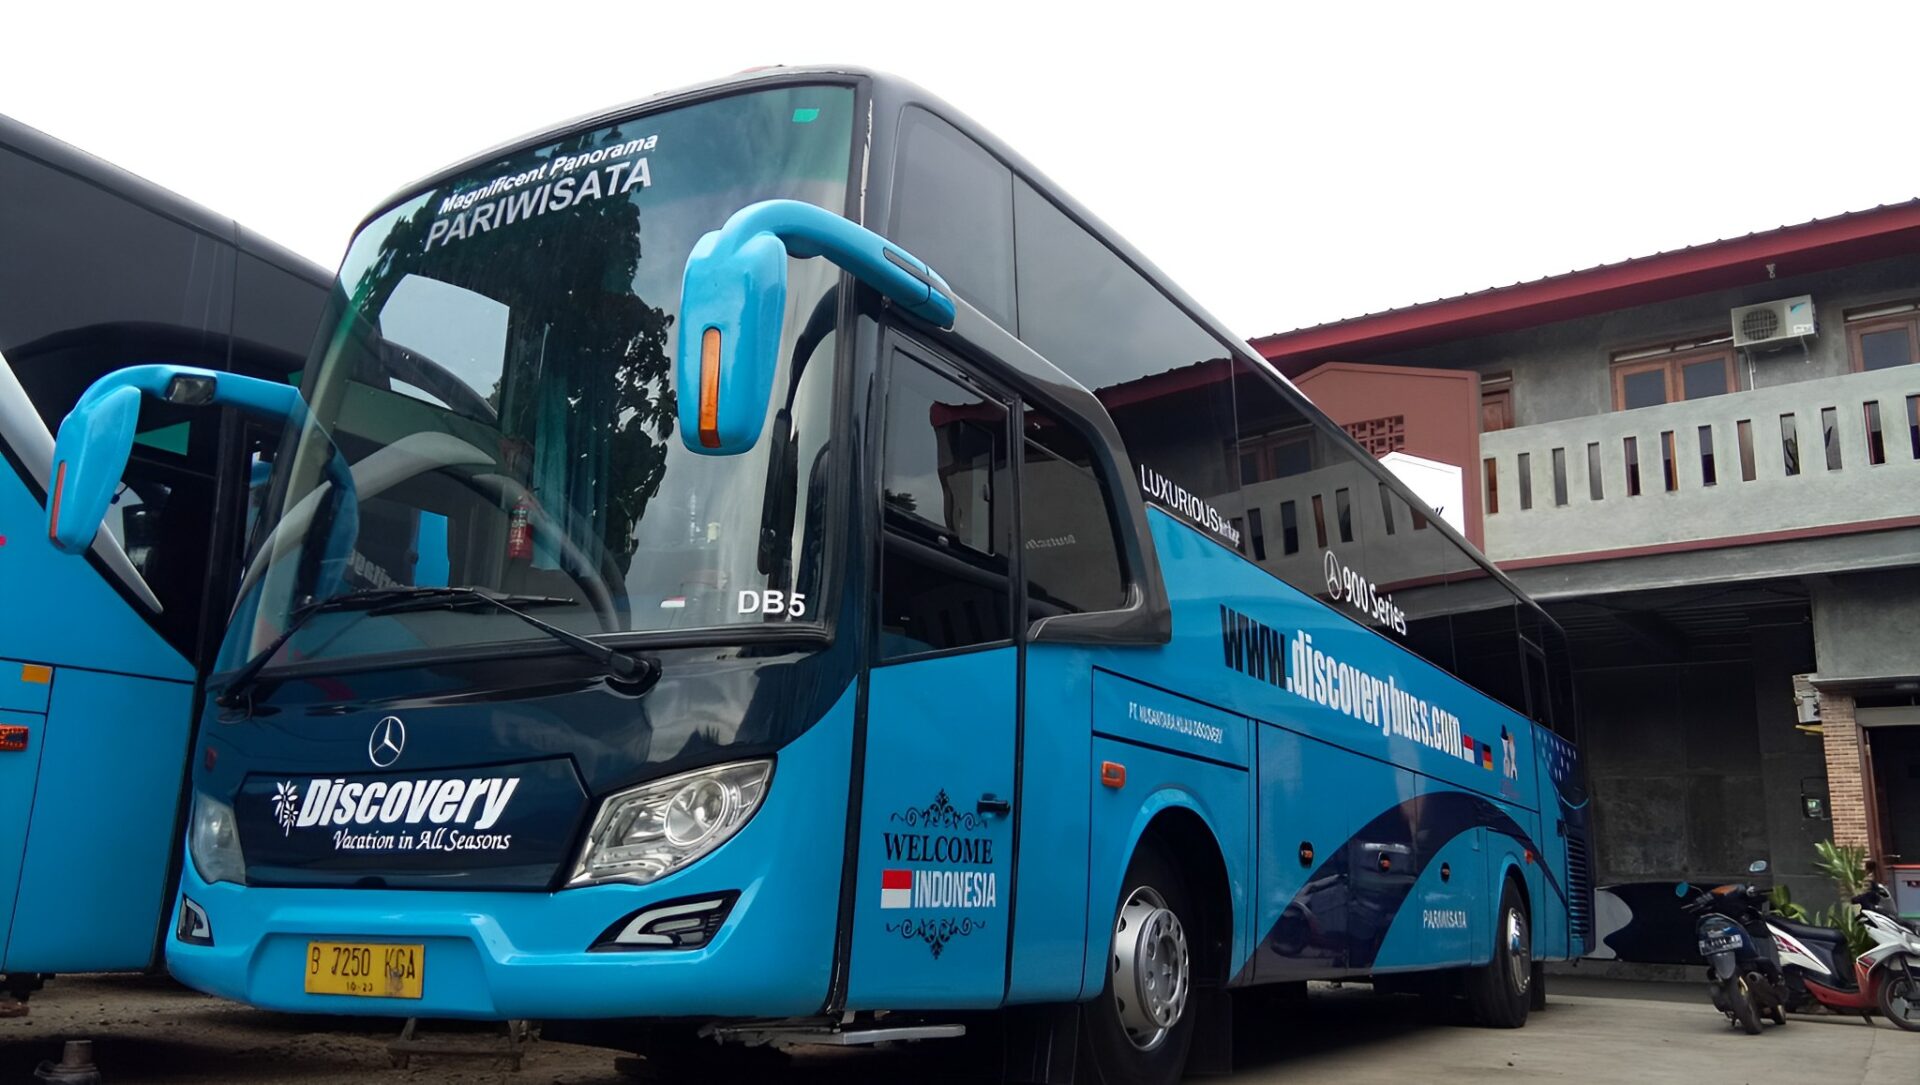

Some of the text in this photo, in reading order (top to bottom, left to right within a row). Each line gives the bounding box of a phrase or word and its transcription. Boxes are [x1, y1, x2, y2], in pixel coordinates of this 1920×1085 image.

[438, 134, 658, 214] Magnificent Panorama
[424, 157, 652, 252] PARIWISATA
[1140, 463, 1220, 532] LUXURIOUS
[1342, 566, 1407, 636] 900 Series
[295, 777, 521, 830] Discovery
[333, 827, 512, 851] Vacation in All Seasons
[882, 832, 994, 865] WELCOME
[914, 869, 997, 908] INDONESIA
[311, 946, 321, 975] B
[331, 946, 371, 977] 7250
